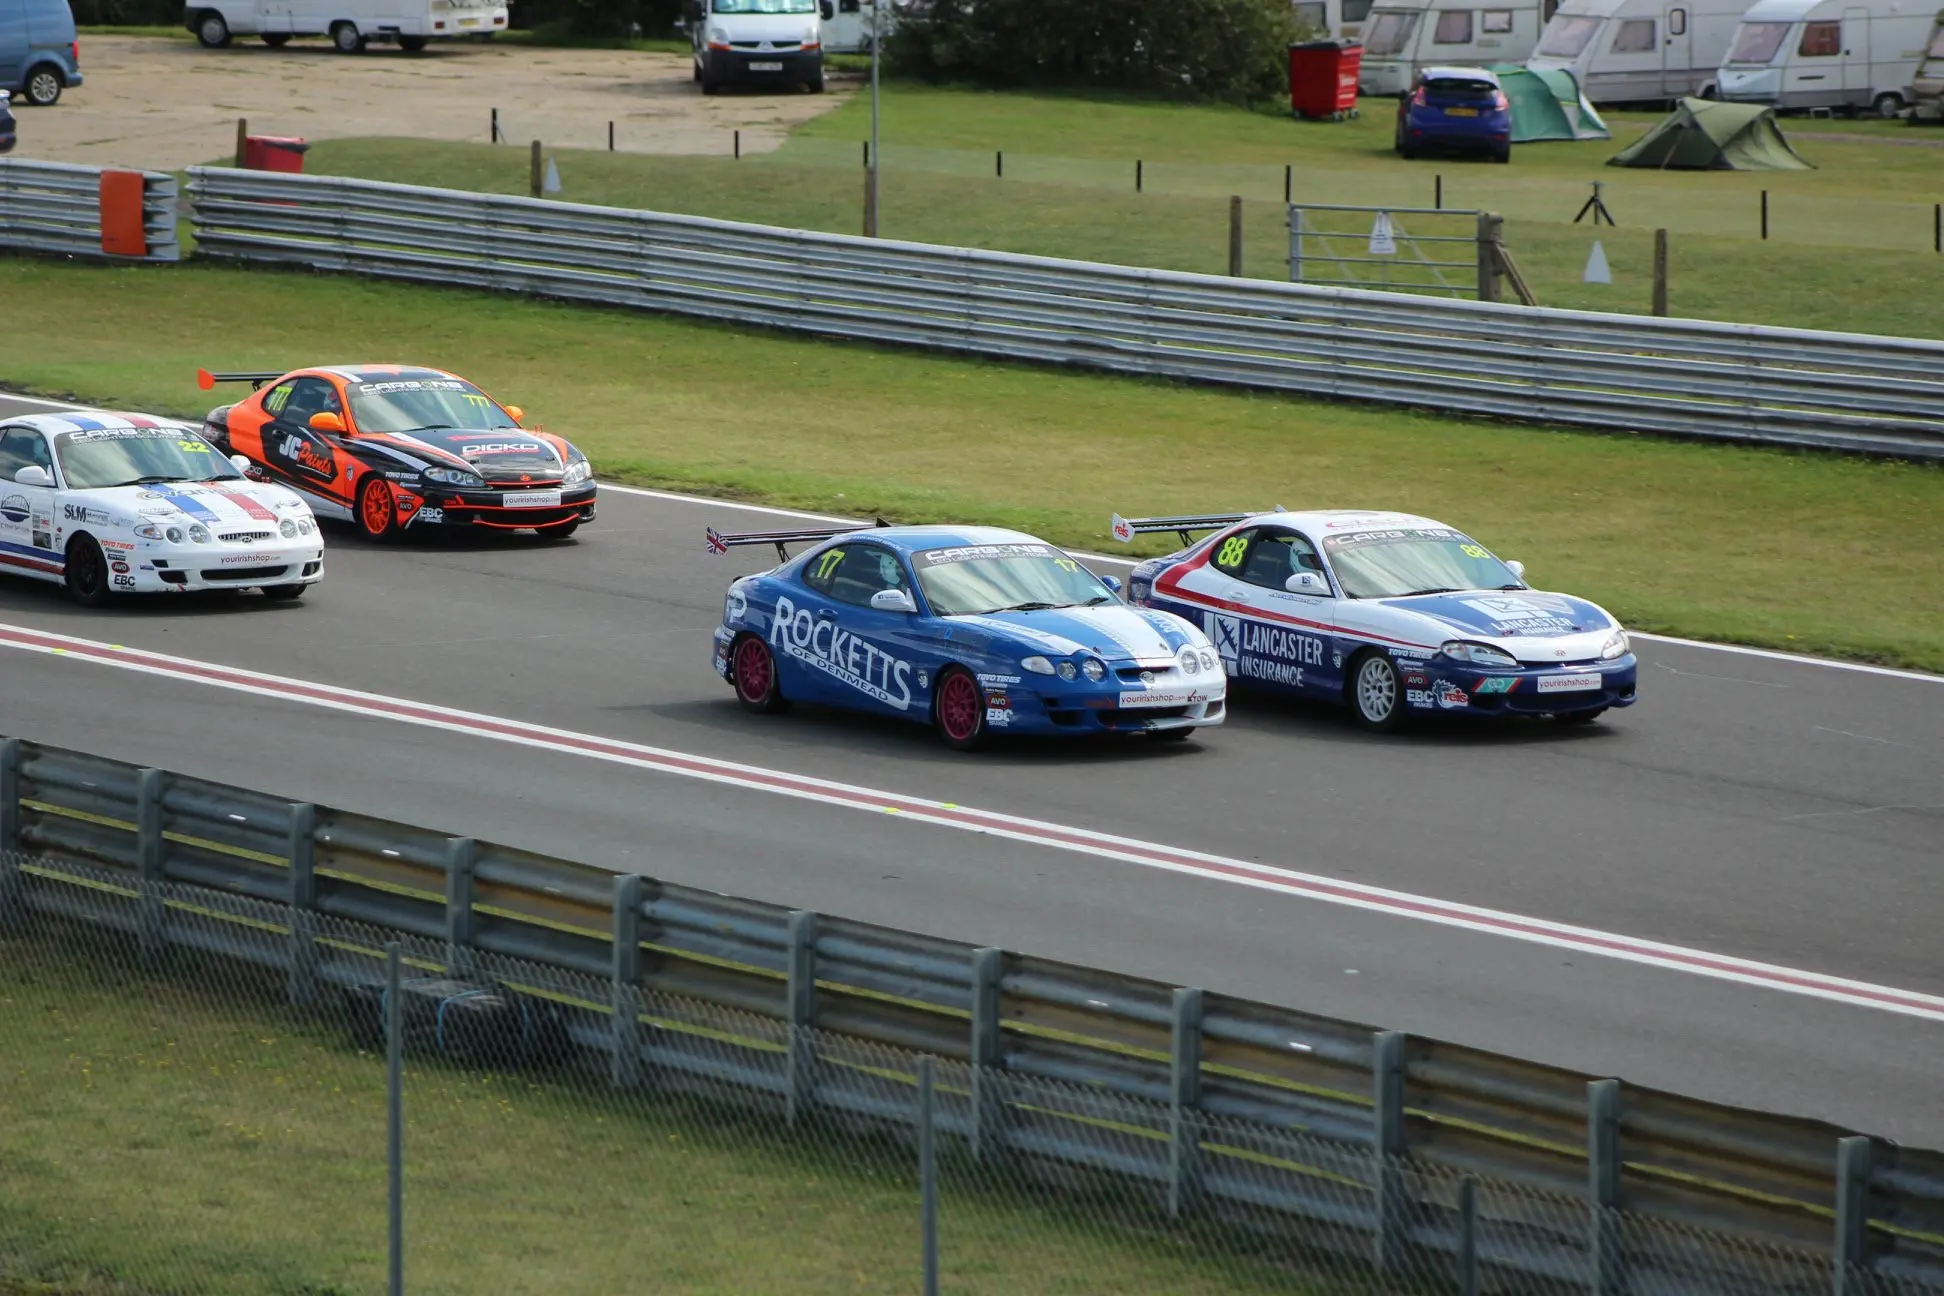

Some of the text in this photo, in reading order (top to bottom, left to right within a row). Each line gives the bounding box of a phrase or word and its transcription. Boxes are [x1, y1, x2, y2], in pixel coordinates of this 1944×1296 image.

[462, 394, 490, 408] 777
[177, 440, 210, 454] 22
[279, 433, 331, 475] JC Paints
[64, 504, 87, 523] SLM
[420, 507, 443, 518] EBC
[1114, 523, 1129, 538] reis
[101, 540, 135, 550] TOYO TIRES
[1218, 536, 1248, 567] 88
[1460, 544, 1490, 559] 88
[816, 547, 846, 580] 17
[1054, 558, 1079, 573] 17
[114, 574, 136, 586] EBC
[1490, 617, 1576, 631] LANCASTER
[1243, 623, 1323, 666] LANCASTER
[770, 595, 911, 711] ROCKETTS
[1388, 648, 1433, 659] TOYO TIRES
[792, 646, 889, 702] OF DENMEAD
[977, 673, 1021, 684] TOYO TIRES
[1241, 655, 1304, 688] INSURANCE
[1407, 676, 1424, 684] AVO
[990, 697, 1006, 706] AVO
[1406, 689, 1434, 702] EBC
[986, 708, 1013, 722] EBC
